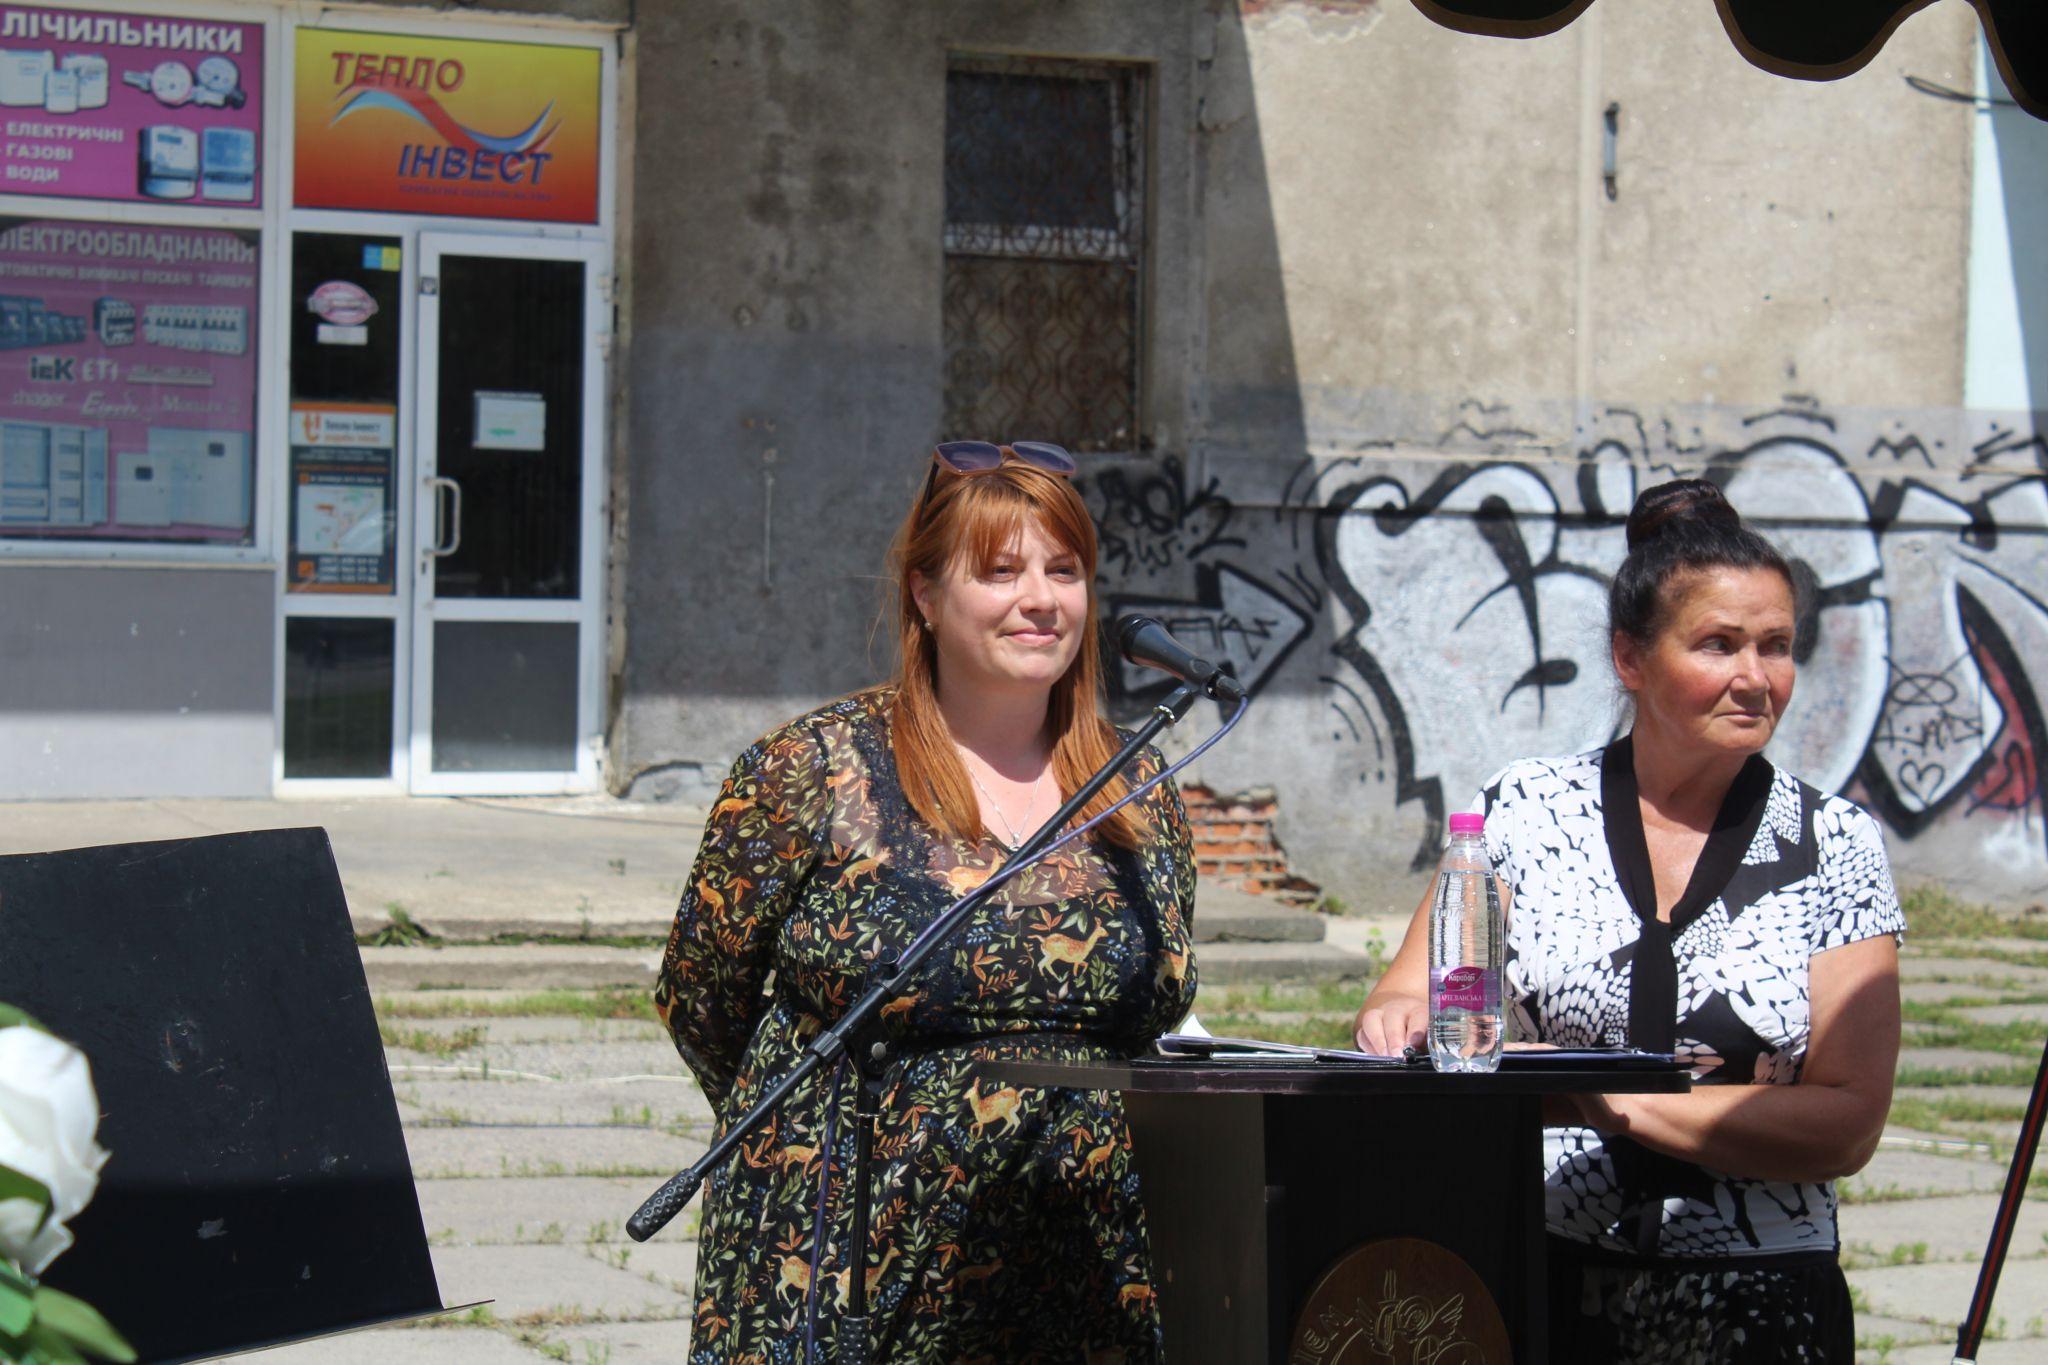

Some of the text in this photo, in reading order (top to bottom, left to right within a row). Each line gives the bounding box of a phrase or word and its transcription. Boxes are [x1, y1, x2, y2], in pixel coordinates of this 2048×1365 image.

[2, 11, 243, 53] ЛІЧИЛЬНИКИ
[331, 52, 466, 92] ТЕПЛО
[6, 121, 124, 142] ЕЛЕКТРИЧНІ
[6, 143, 74, 161] ГАЗОВІ
[397, 144, 553, 185] ІНВЕСТ
[6, 165, 59, 182] ВОДИ
